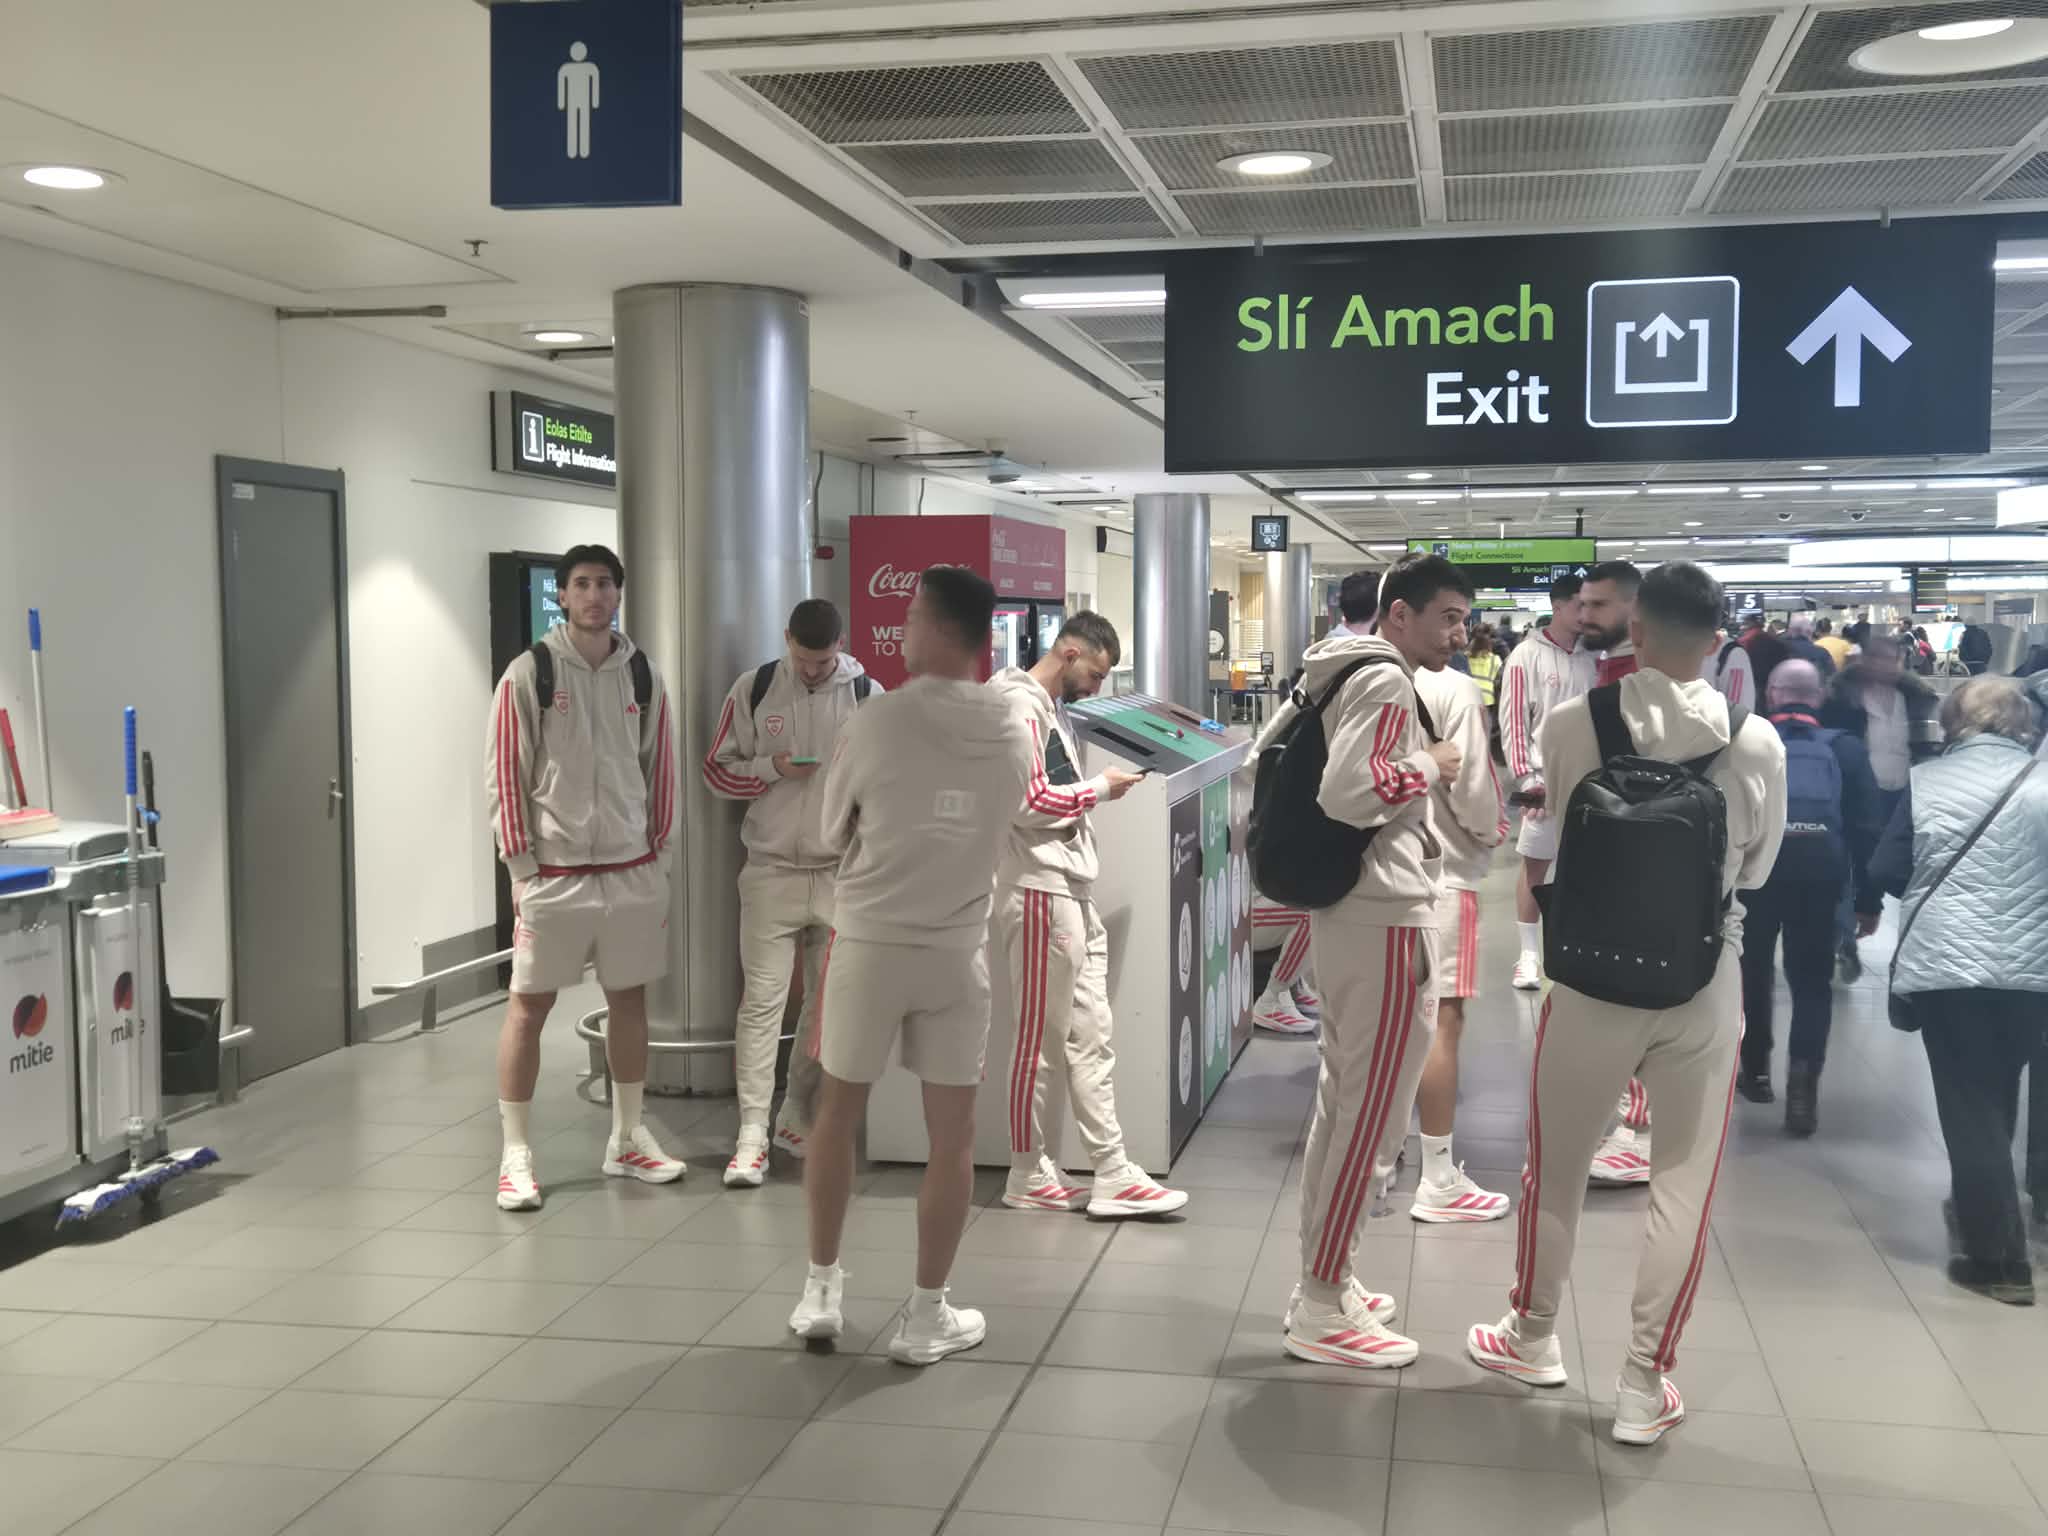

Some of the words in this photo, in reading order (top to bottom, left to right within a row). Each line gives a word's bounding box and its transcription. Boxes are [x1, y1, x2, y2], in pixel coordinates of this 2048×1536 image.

[1237, 293, 1313, 352] Slí
[1330, 283, 1554, 348] Amach
[1426, 369, 1549, 425] Exit
[545, 418, 568, 439] Eolas
[546, 442, 571, 468] Flight
[1533, 575, 1549, 584] Exit
[1743, 593, 1757, 609] 5
[872, 641, 896, 656] TO
[10, 1042, 53, 1073] mitie
